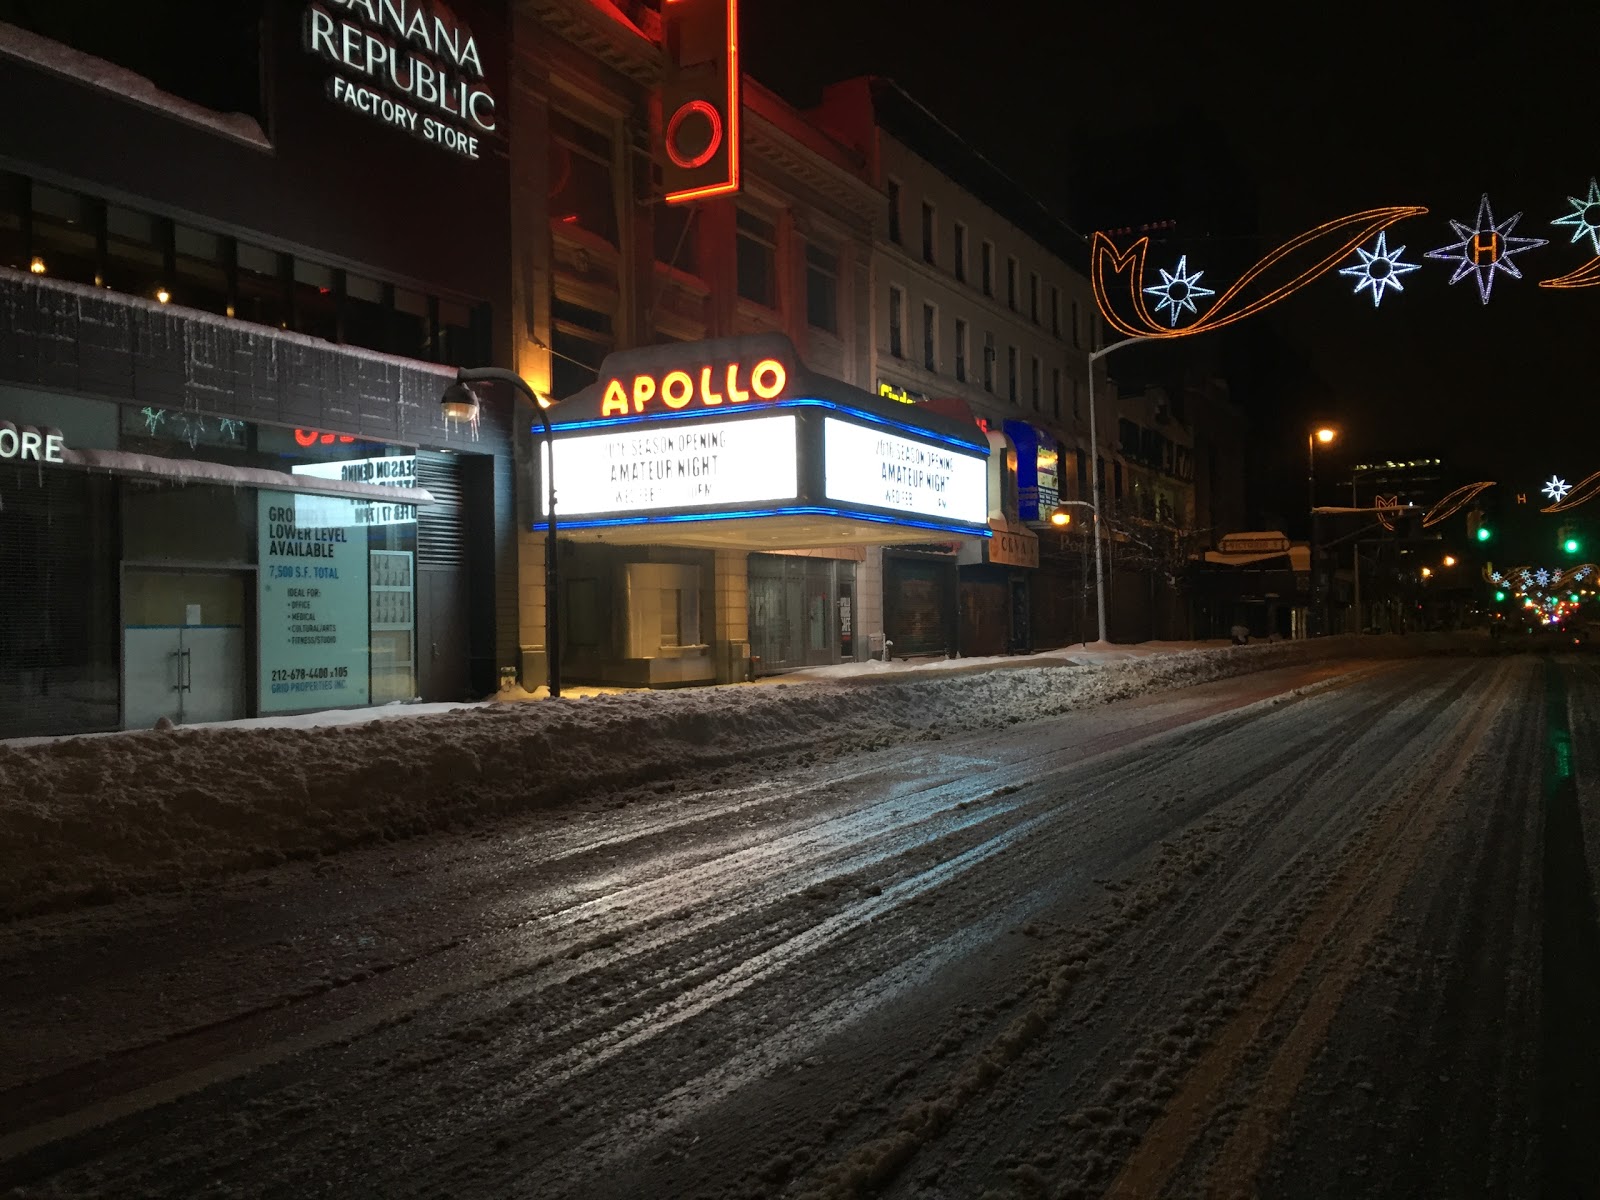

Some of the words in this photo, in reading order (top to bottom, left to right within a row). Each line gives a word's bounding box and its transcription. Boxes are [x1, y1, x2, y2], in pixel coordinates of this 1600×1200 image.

[333, 0, 485, 77] ANANA
[311, 8, 496, 131] REPUBLIC
[334, 76, 418, 130] FACTORY
[423, 117, 480, 159] STORE
[601, 358, 787, 417] APOLLO
[0, 428, 64, 463] ORE
[631, 436, 674, 456] SEASON
[678, 430, 726, 452] OPENING
[896, 443, 925, 465] SEASON
[610, 459, 673, 482] AMATEUR
[677, 454, 718, 477] NIGHT
[881, 461, 924, 488] AMATEUR
[926, 472, 950, 492] NIGHT
[269, 524, 311, 541] LOWER
[315, 528, 347, 543] LEVEL
[269, 541, 334, 558] AVAILABLE
[295, 566, 312, 579] S.F.
[314, 567, 339, 580] TOTAL
[287, 588, 305, 597] IDEAL
[307, 588, 321, 597] FOR:
[292, 601, 310, 609] OFFICE
[292, 612, 315, 621] MEDICAL
[292, 624, 336, 633] CULTURAL/ARTS
[292, 635, 336, 645] FITNESS/STUDIO
[271, 667, 328, 681] 212-678-4400
[272, 682, 289, 694] GRID
[290, 680, 333, 692] PROPERTIES
